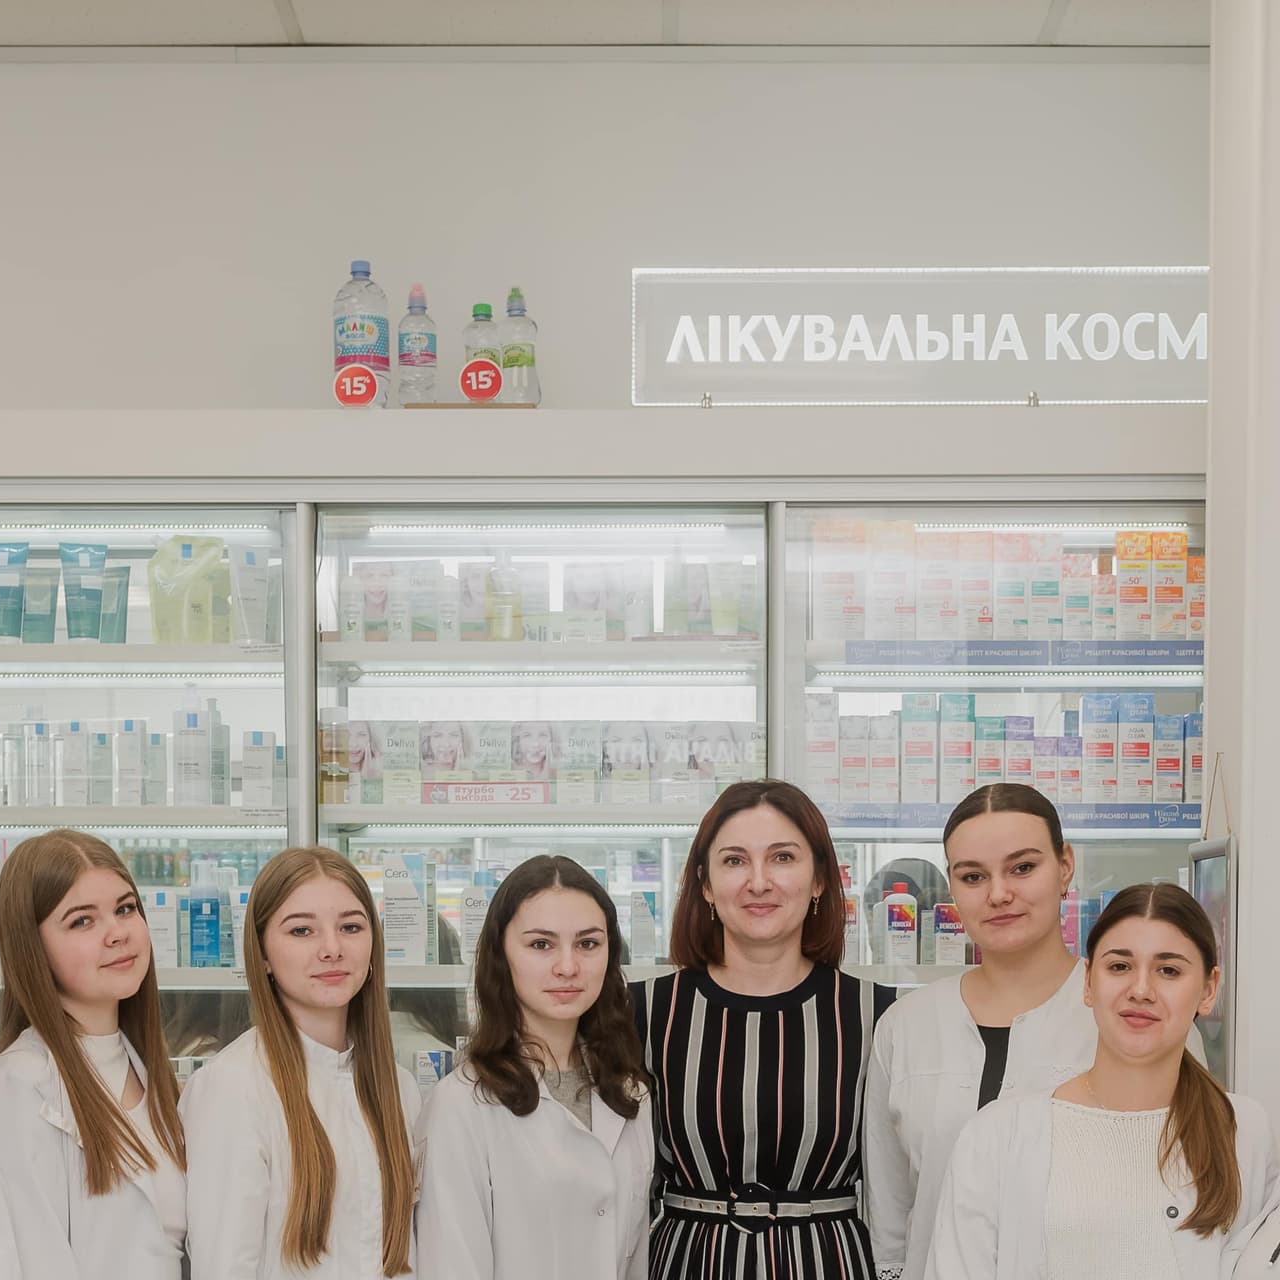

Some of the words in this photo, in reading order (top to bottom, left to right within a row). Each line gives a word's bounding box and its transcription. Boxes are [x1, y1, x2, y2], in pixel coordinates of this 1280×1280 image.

[665, 314, 1029, 362] ЛІКУВАЛЬНА
[1045, 312, 1208, 361] КОСМ
[1085, 648, 1110, 656] РЕЦЕПТ
[1112, 648, 1145, 656] КРАСИВОЇ
[1147, 648, 1170, 656] ШКІРИ
[454, 786, 495, 796] #турбо
